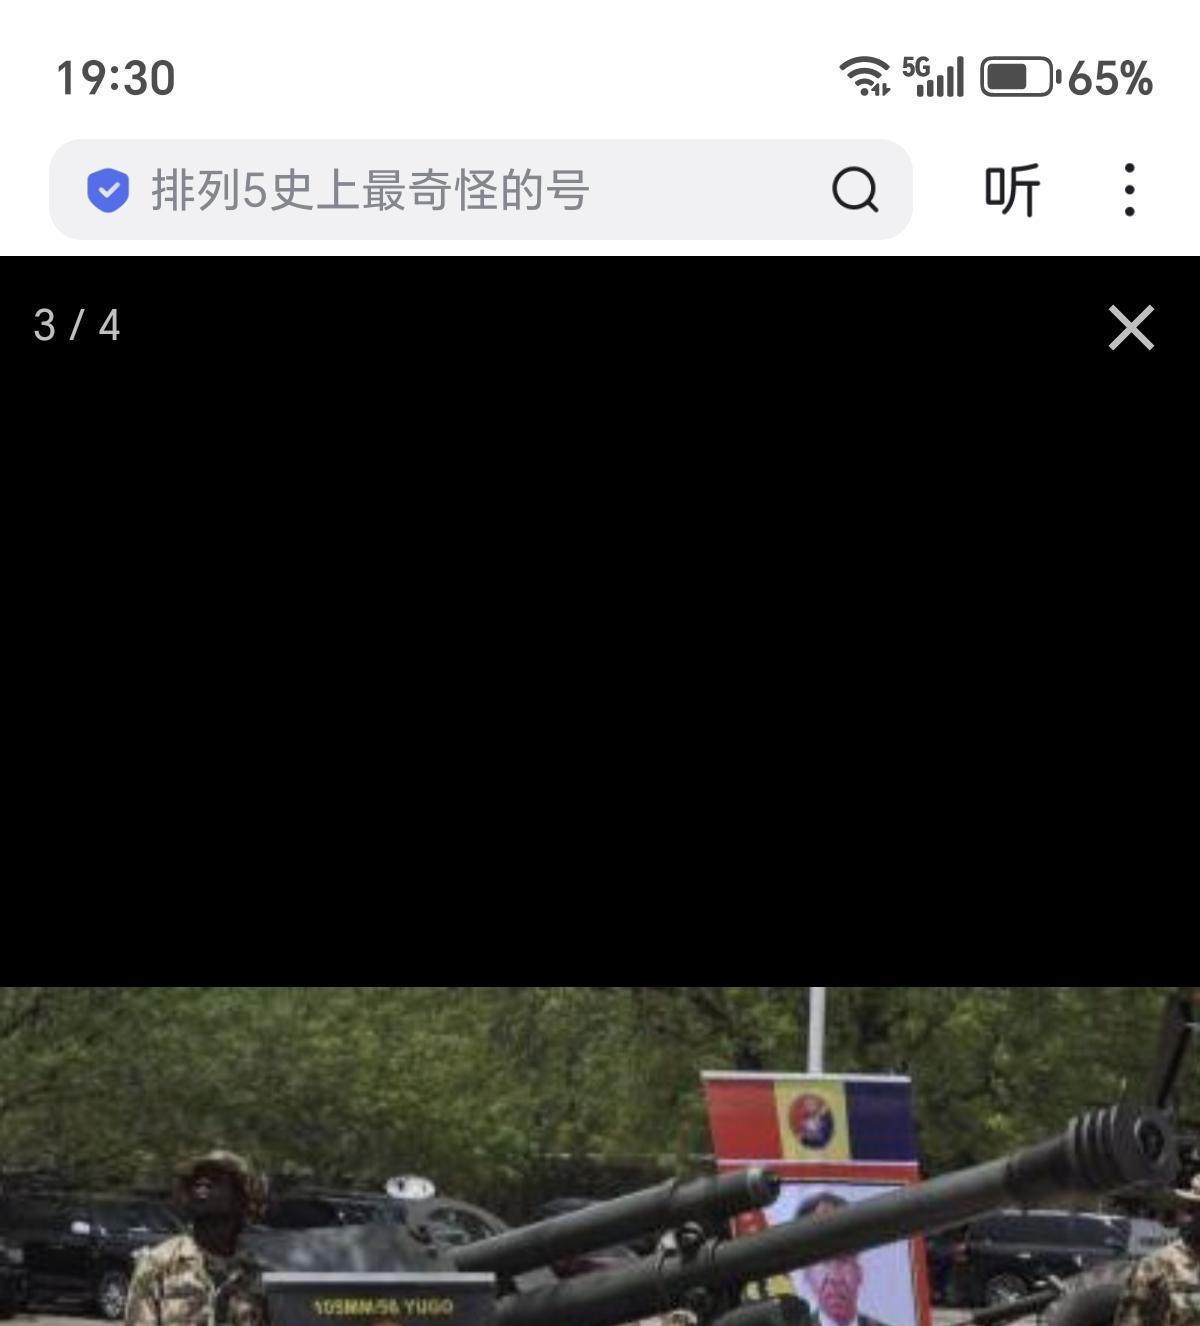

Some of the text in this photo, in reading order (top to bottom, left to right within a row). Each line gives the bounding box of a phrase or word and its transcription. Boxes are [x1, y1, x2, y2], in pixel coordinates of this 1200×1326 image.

[59, 59, 175, 96] 19:30
[902, 56, 931, 77] 5G
[1068, 59, 1153, 96] 65%
[151, 167, 590, 212] 排列5史上最奇怪的号
[985, 162, 1041, 218] 听
[34, 307, 55, 342] 3
[98, 308, 120, 341] 4
